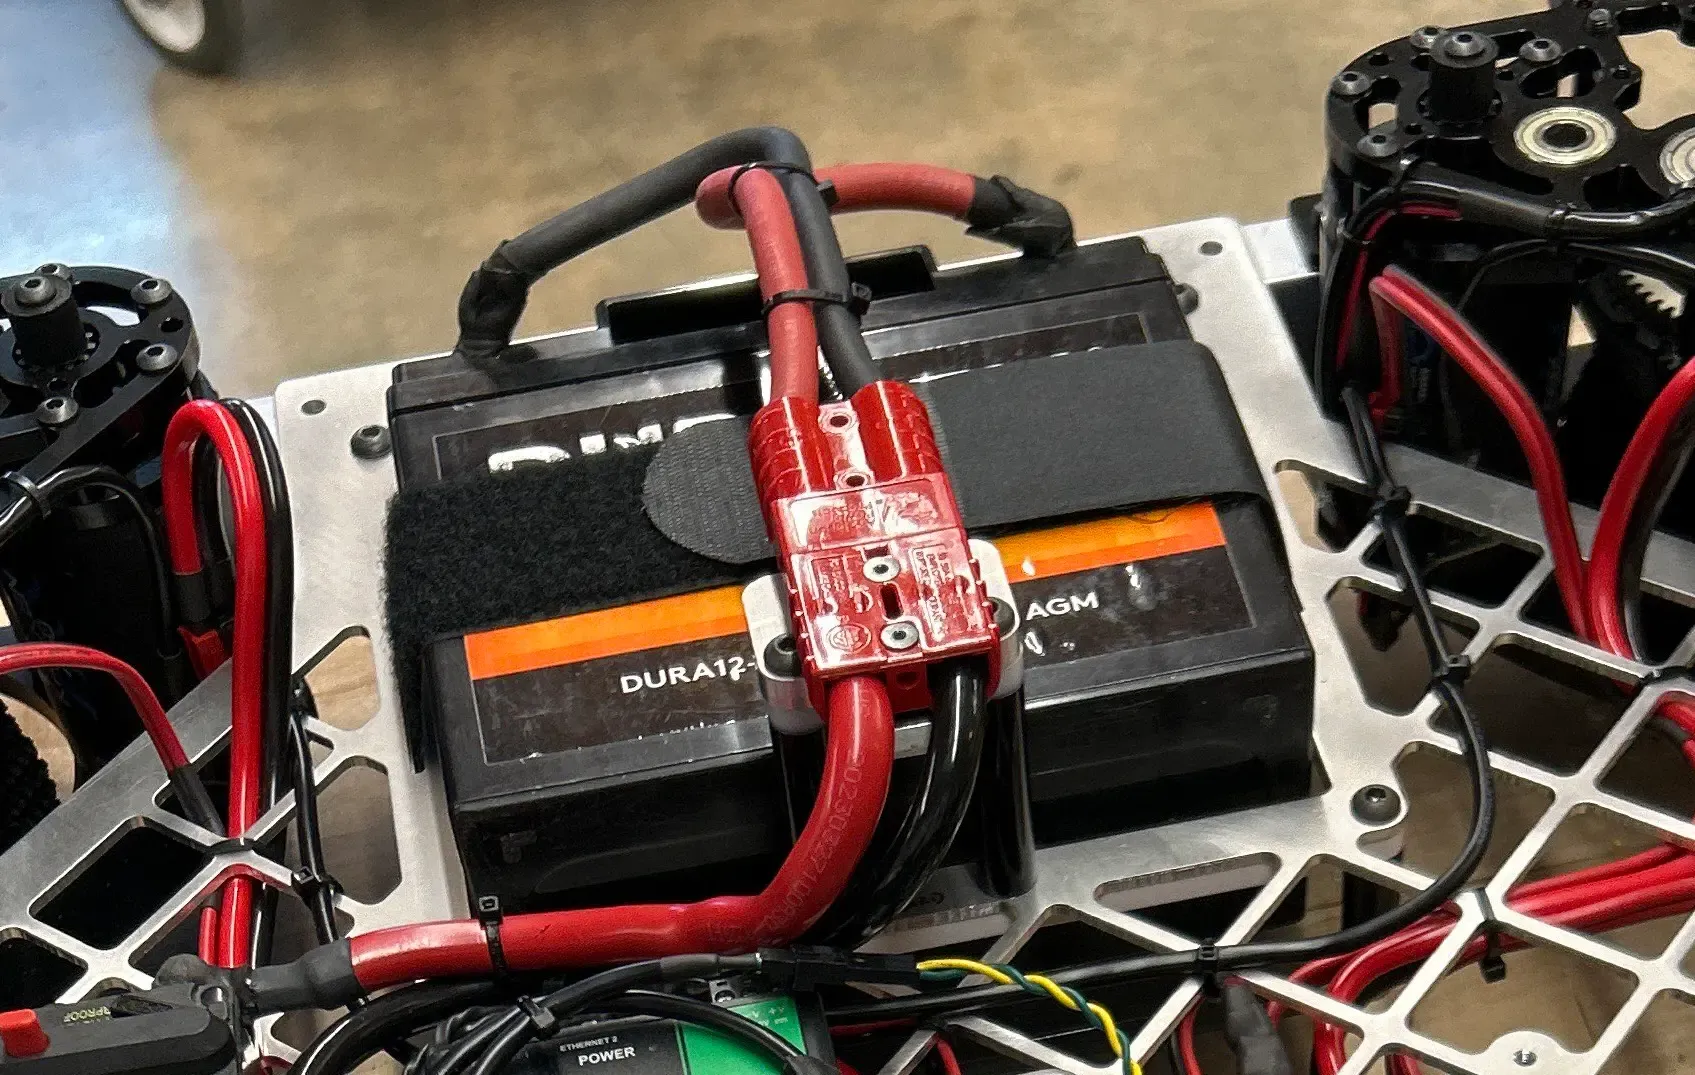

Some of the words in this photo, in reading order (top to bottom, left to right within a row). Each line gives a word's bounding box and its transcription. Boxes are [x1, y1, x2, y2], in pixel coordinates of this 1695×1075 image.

[620, 656, 757, 694] DURA12-
[1026, 591, 1099, 620] AGM
[560, 1036, 610, 1052] ETHERNET
[578, 1046, 636, 1066] POWER
